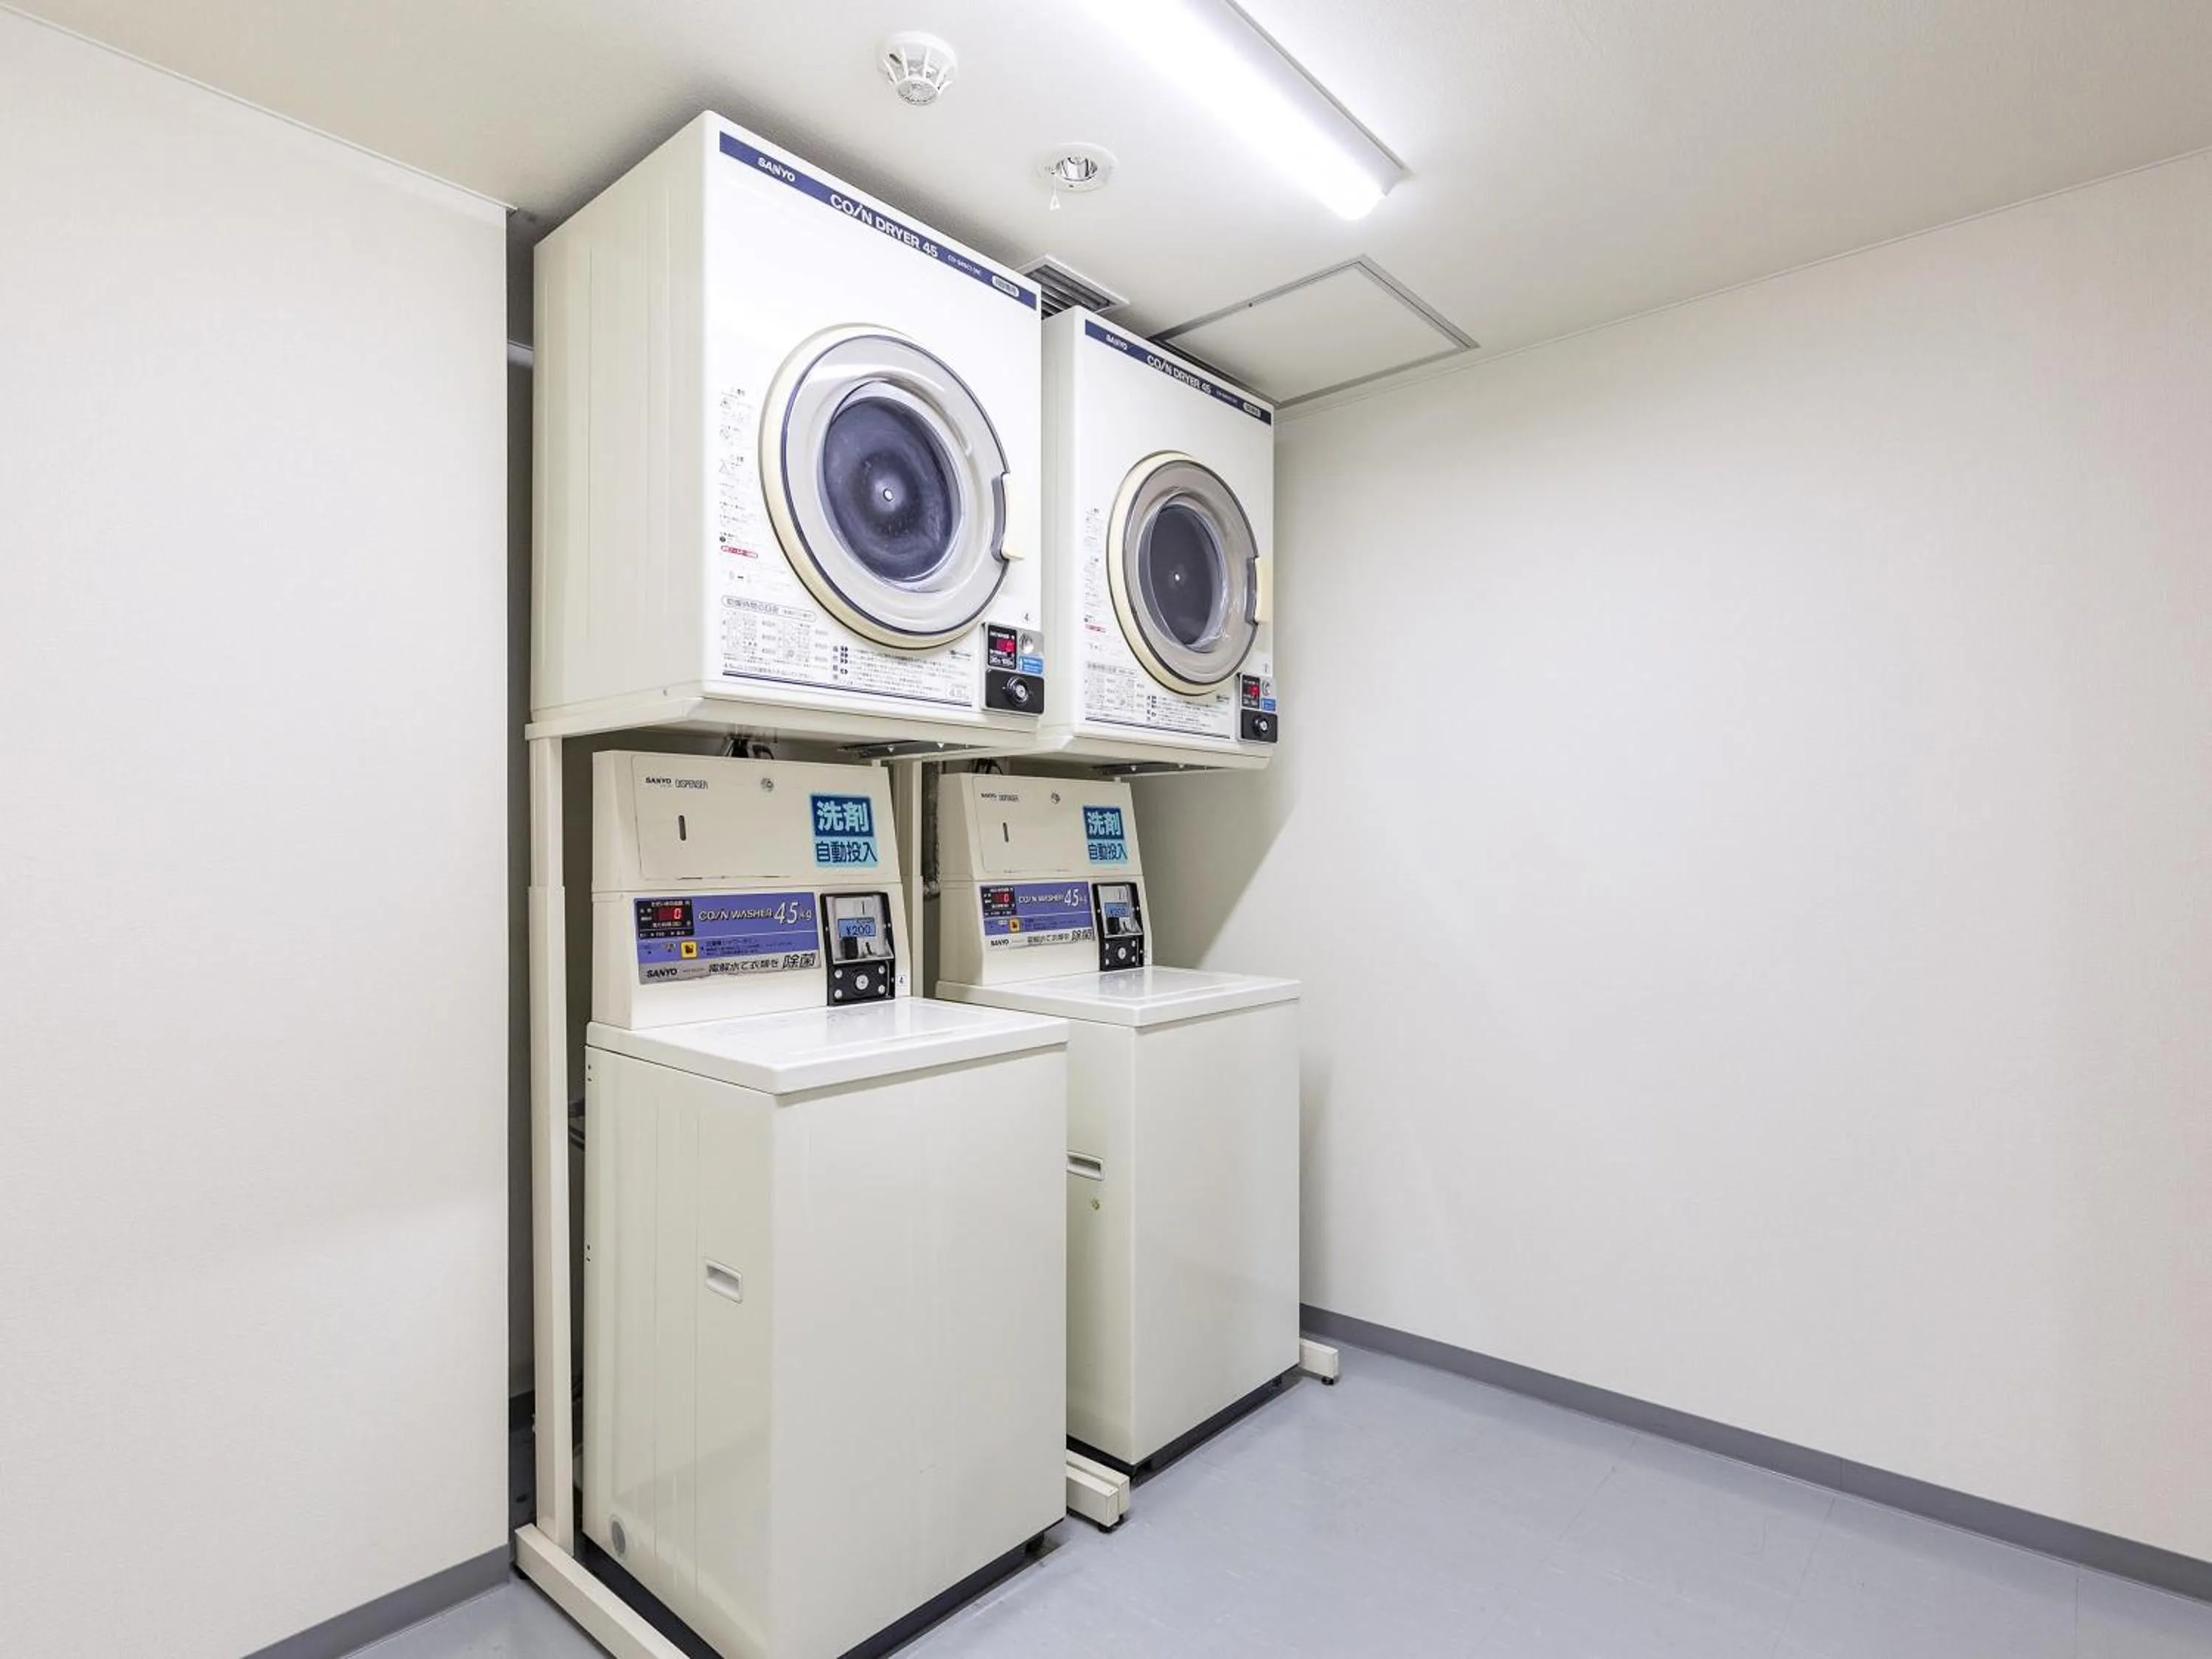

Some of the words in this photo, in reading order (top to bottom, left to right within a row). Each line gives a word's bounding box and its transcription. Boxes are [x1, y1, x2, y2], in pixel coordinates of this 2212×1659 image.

[758, 157, 796, 183] SANYO
[875, 215, 920, 249] DRYER
[922, 240, 939, 259] 45
[1106, 334, 1127, 350] SANYO
[1173, 367, 1200, 389] DRYER
[1201, 383, 1211, 395] 45
[645, 776, 672, 785] SANYO
[675, 779, 709, 790] DISPENSER
[816, 800, 869, 832] 洗剤
[1088, 811, 1121, 836] 洗剤
[815, 841, 877, 863] 自動投入
[1088, 843, 1127, 860] 自動投入
[673, 908, 682, 919] 0
[731, 908, 773, 919] WASHER
[846, 924, 871, 936] ¥200
[990, 939, 1009, 947] SANYO
[782, 952, 817, 969] 除菌
[647, 967, 678, 978] SANYO
